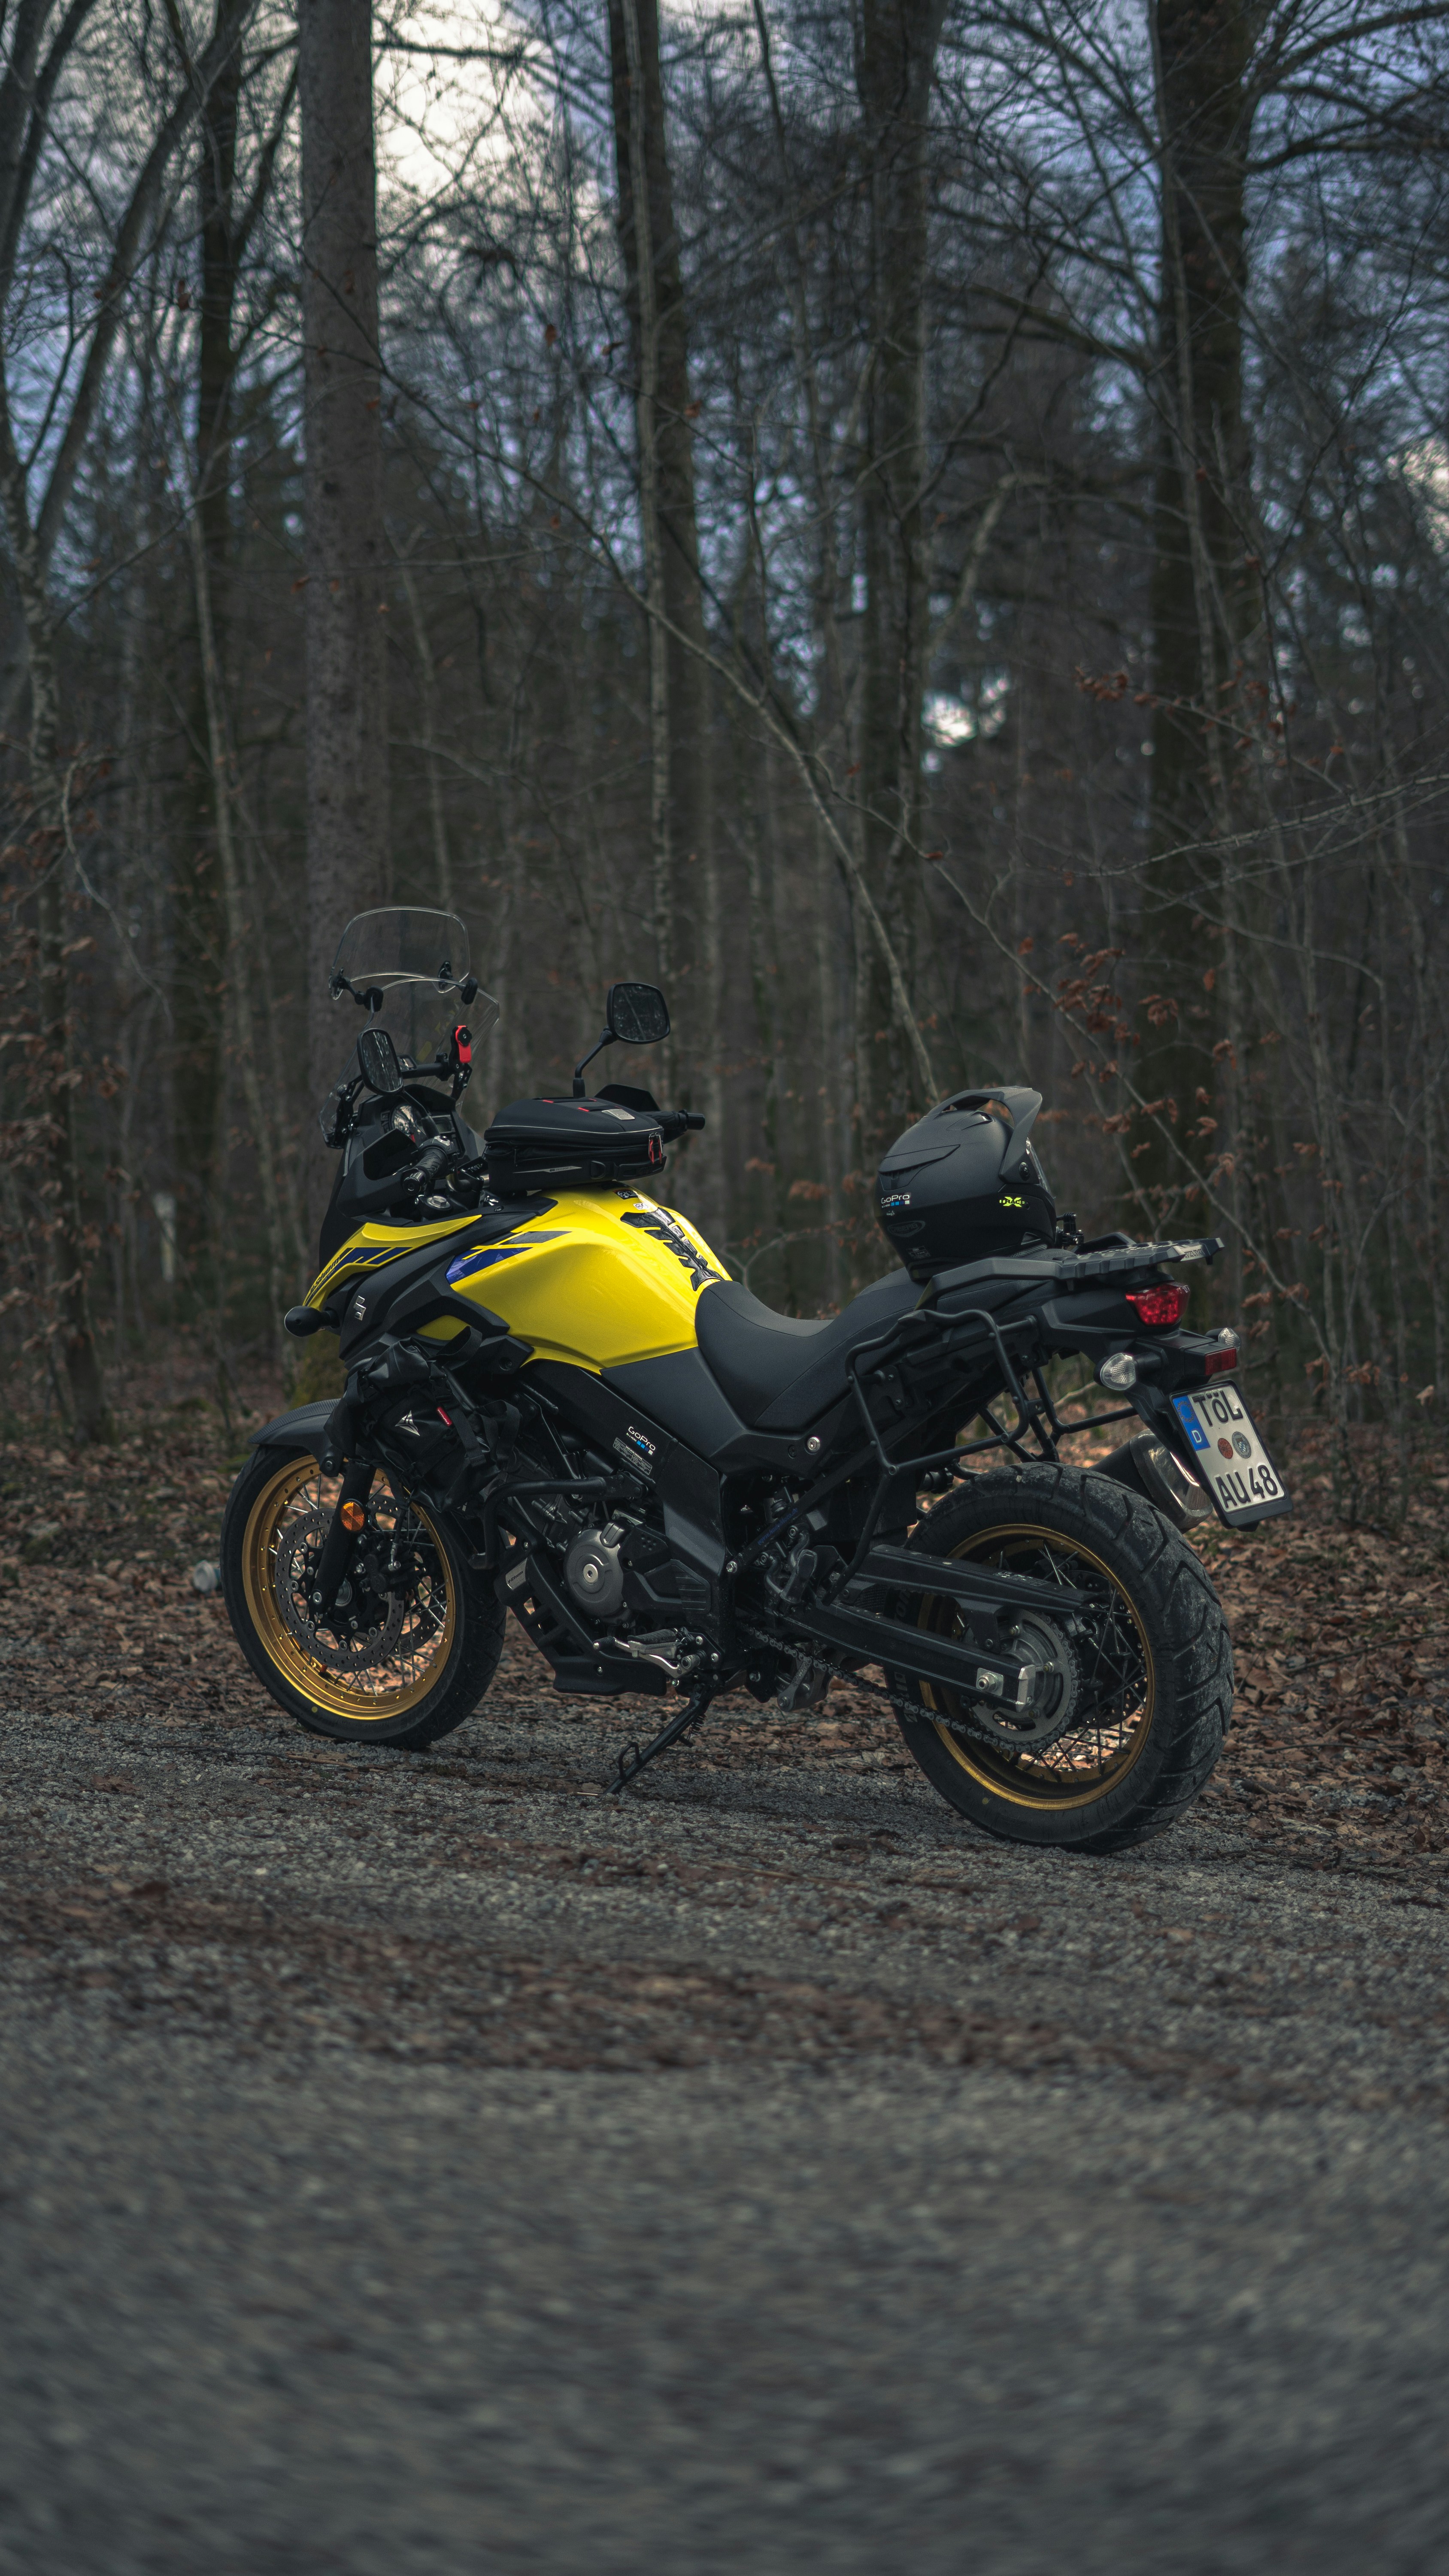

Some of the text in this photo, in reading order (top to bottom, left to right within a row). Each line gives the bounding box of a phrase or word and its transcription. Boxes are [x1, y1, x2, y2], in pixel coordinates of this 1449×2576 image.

[881, 1194, 909, 1204] GoPro
[1192, 1389, 1243, 1426] TÖL
[628, 1426, 656, 1451] GoPro
[1191, 1430, 1201, 1443] D
[1216, 1464, 1278, 1508] AU 48
